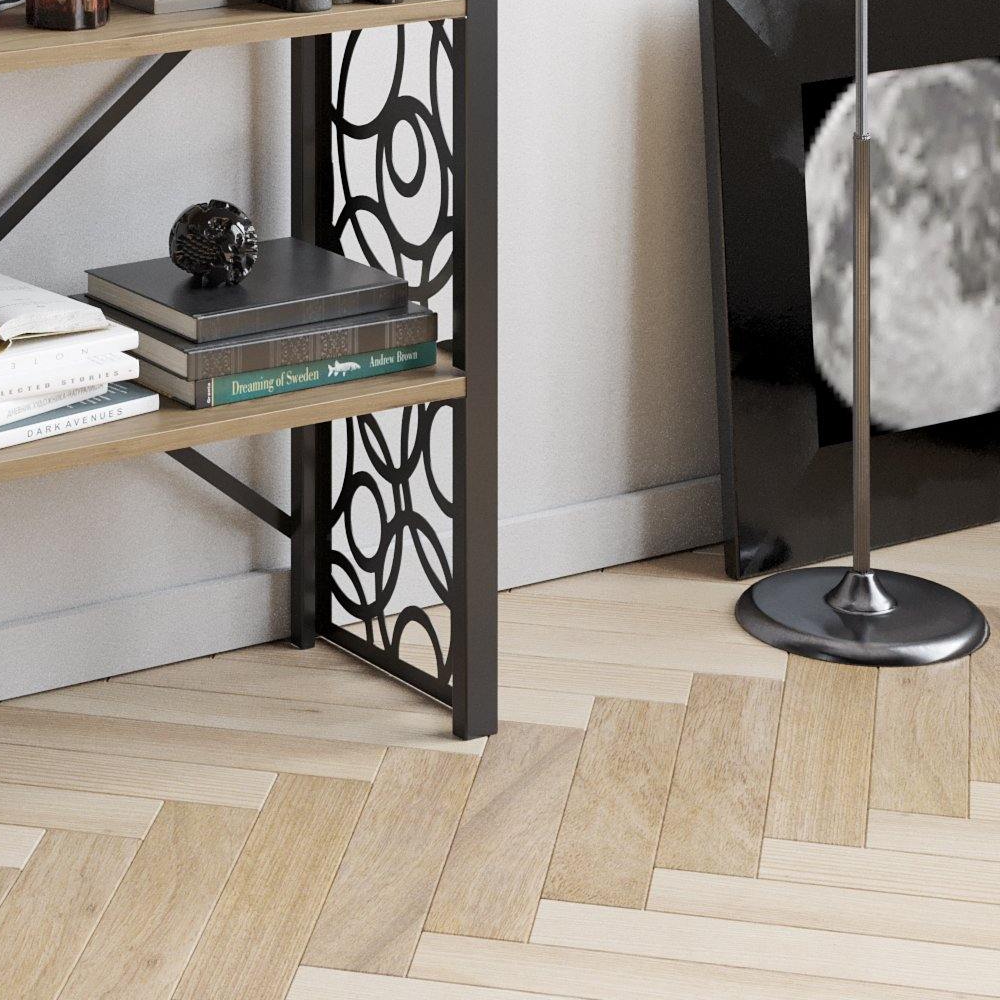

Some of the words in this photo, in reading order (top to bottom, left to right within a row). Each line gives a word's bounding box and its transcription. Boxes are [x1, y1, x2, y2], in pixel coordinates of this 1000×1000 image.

[369, 353, 394, 368] Andrew
[396, 350, 418, 363] Brown
[61, 370, 120, 386] STORIES
[231, 374, 274, 396] Dreaming
[275, 372, 285, 387] of
[286, 367, 320, 384] Sweden
[27, 422, 62, 438] DARK
[65, 408, 124, 429] AVENUES
